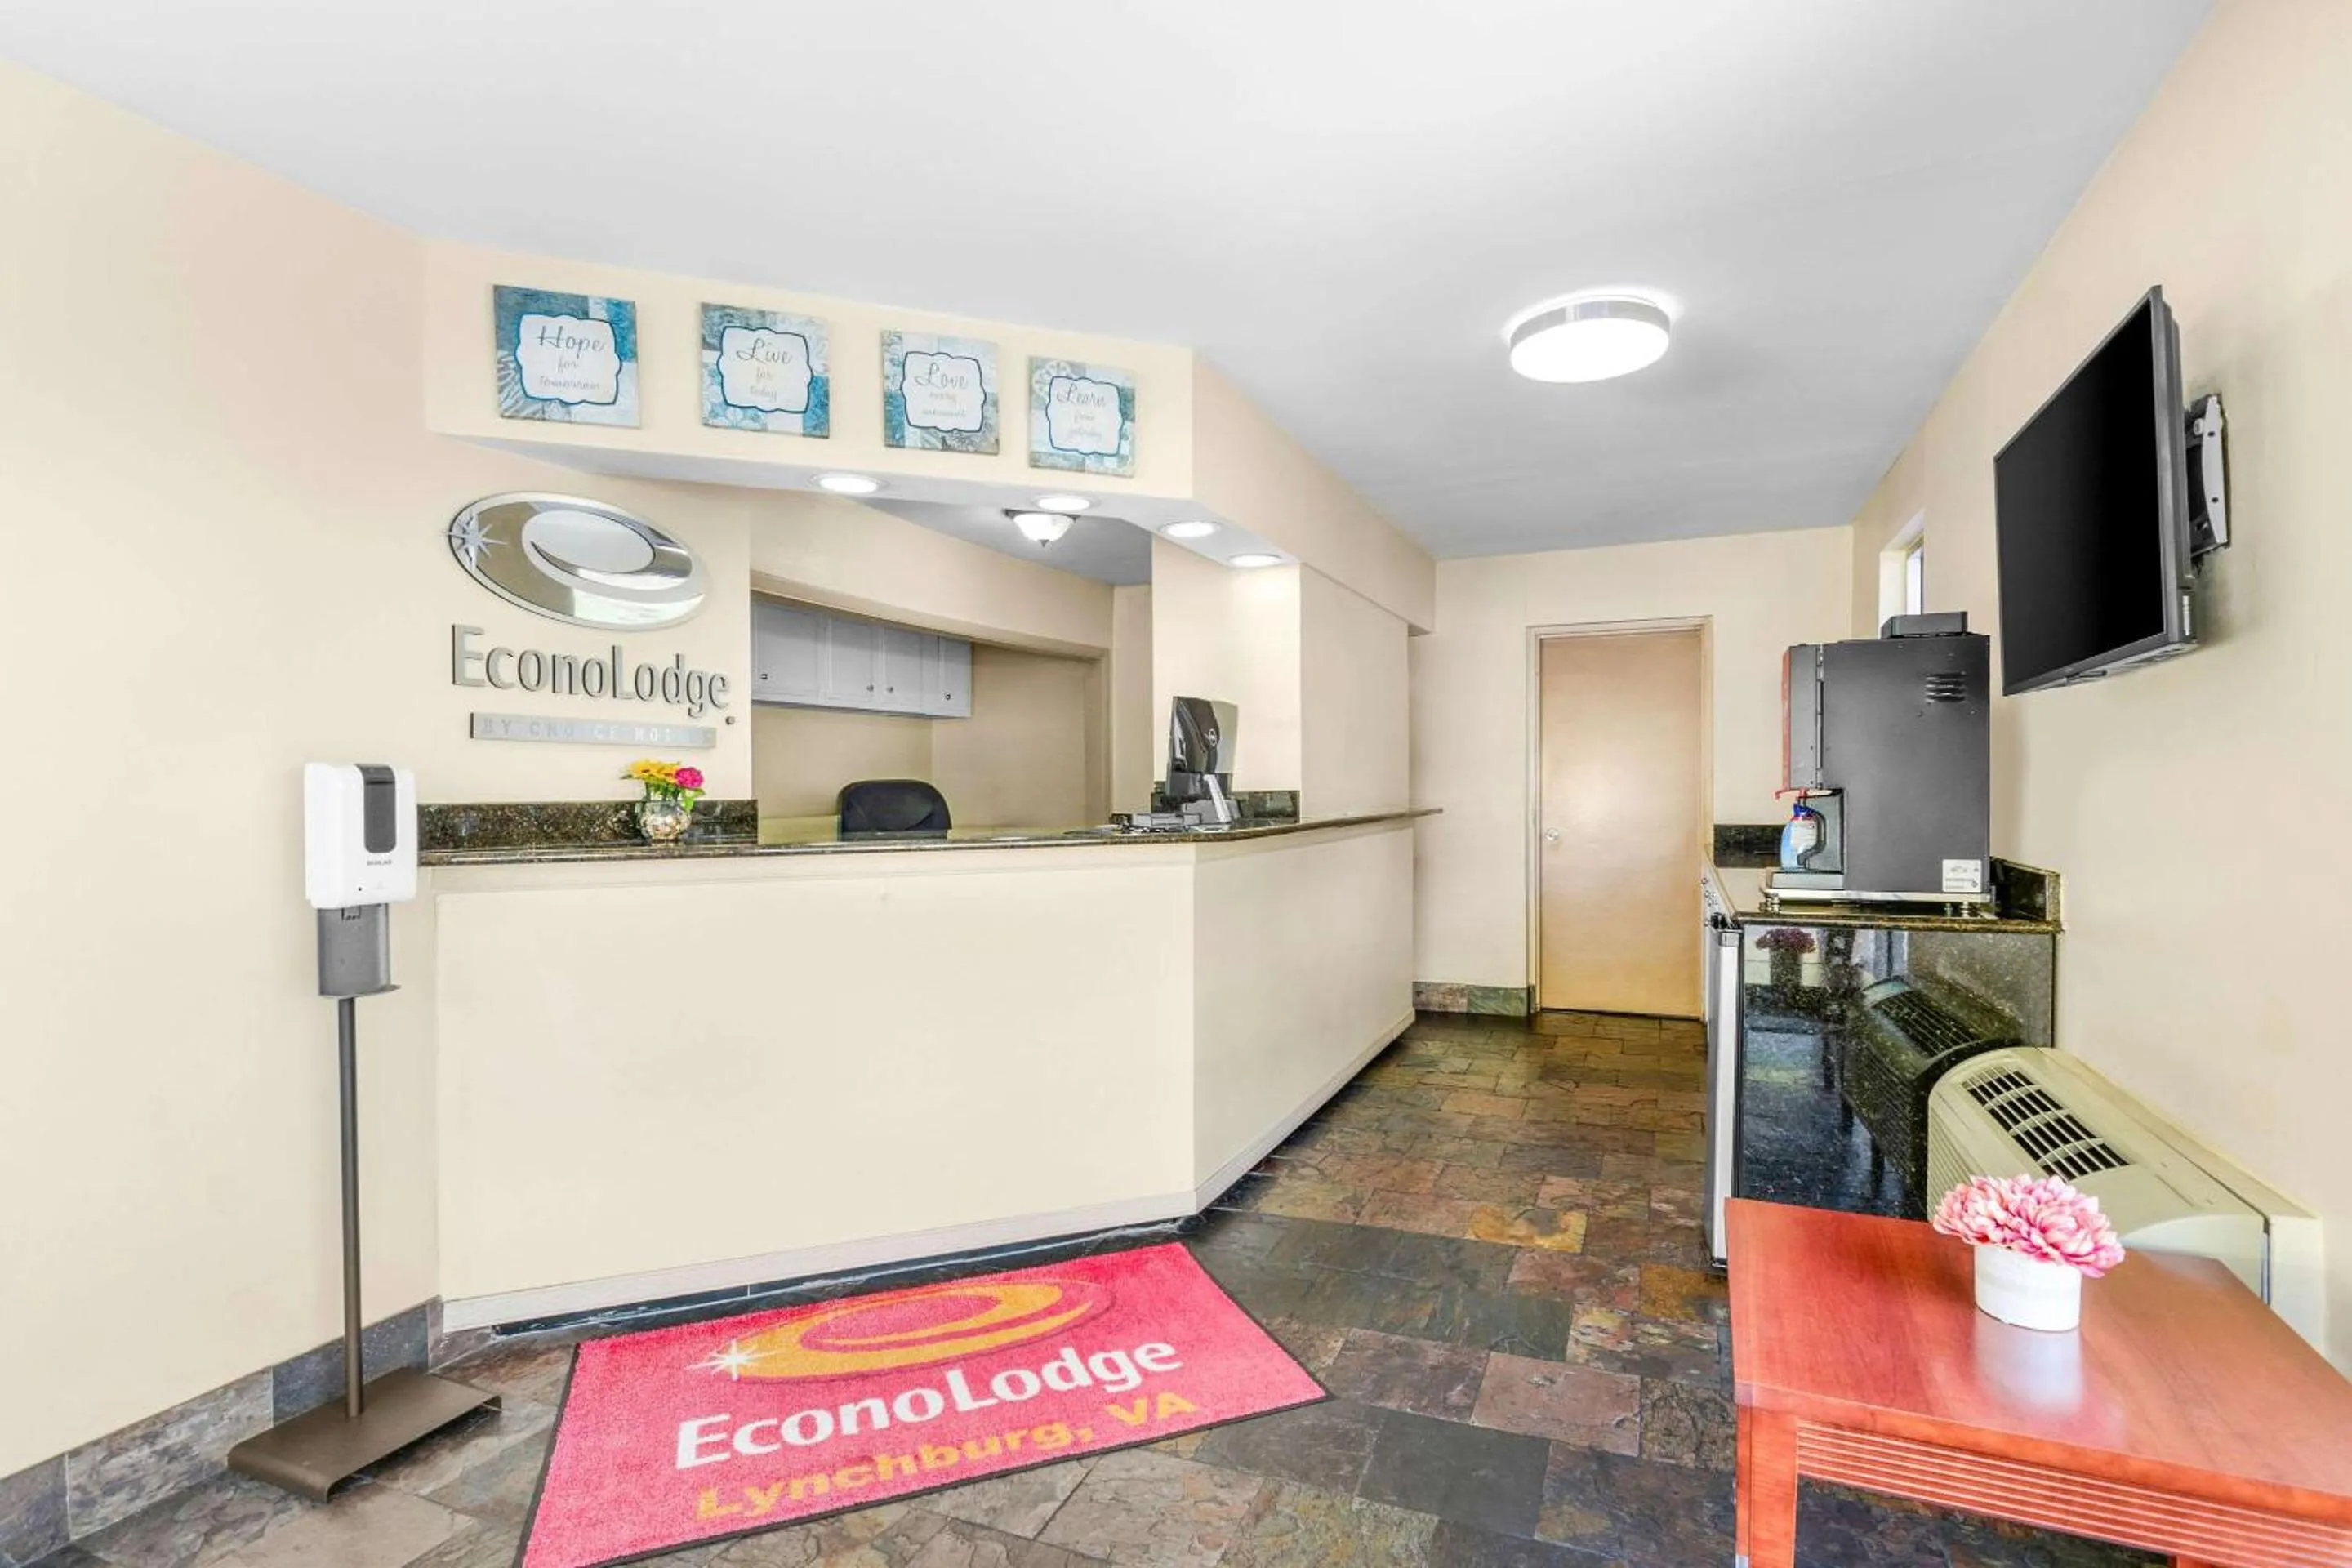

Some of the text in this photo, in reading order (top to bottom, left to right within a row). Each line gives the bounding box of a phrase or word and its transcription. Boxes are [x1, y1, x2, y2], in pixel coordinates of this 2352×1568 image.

[535, 324, 605, 359] Hope
[735, 337, 794, 365] Live
[557, 355, 579, 373] for
[913, 362, 969, 390] Love
[1056, 382, 1107, 409] Learn
[451, 623, 730, 719] EconoLodge
[481, 718, 512, 735] BY
[529, 719, 619, 741] CHOCE
[675, 1341, 1183, 1470] EconoLodge
[696, 1390, 1198, 1521] Lynchburg, VA
